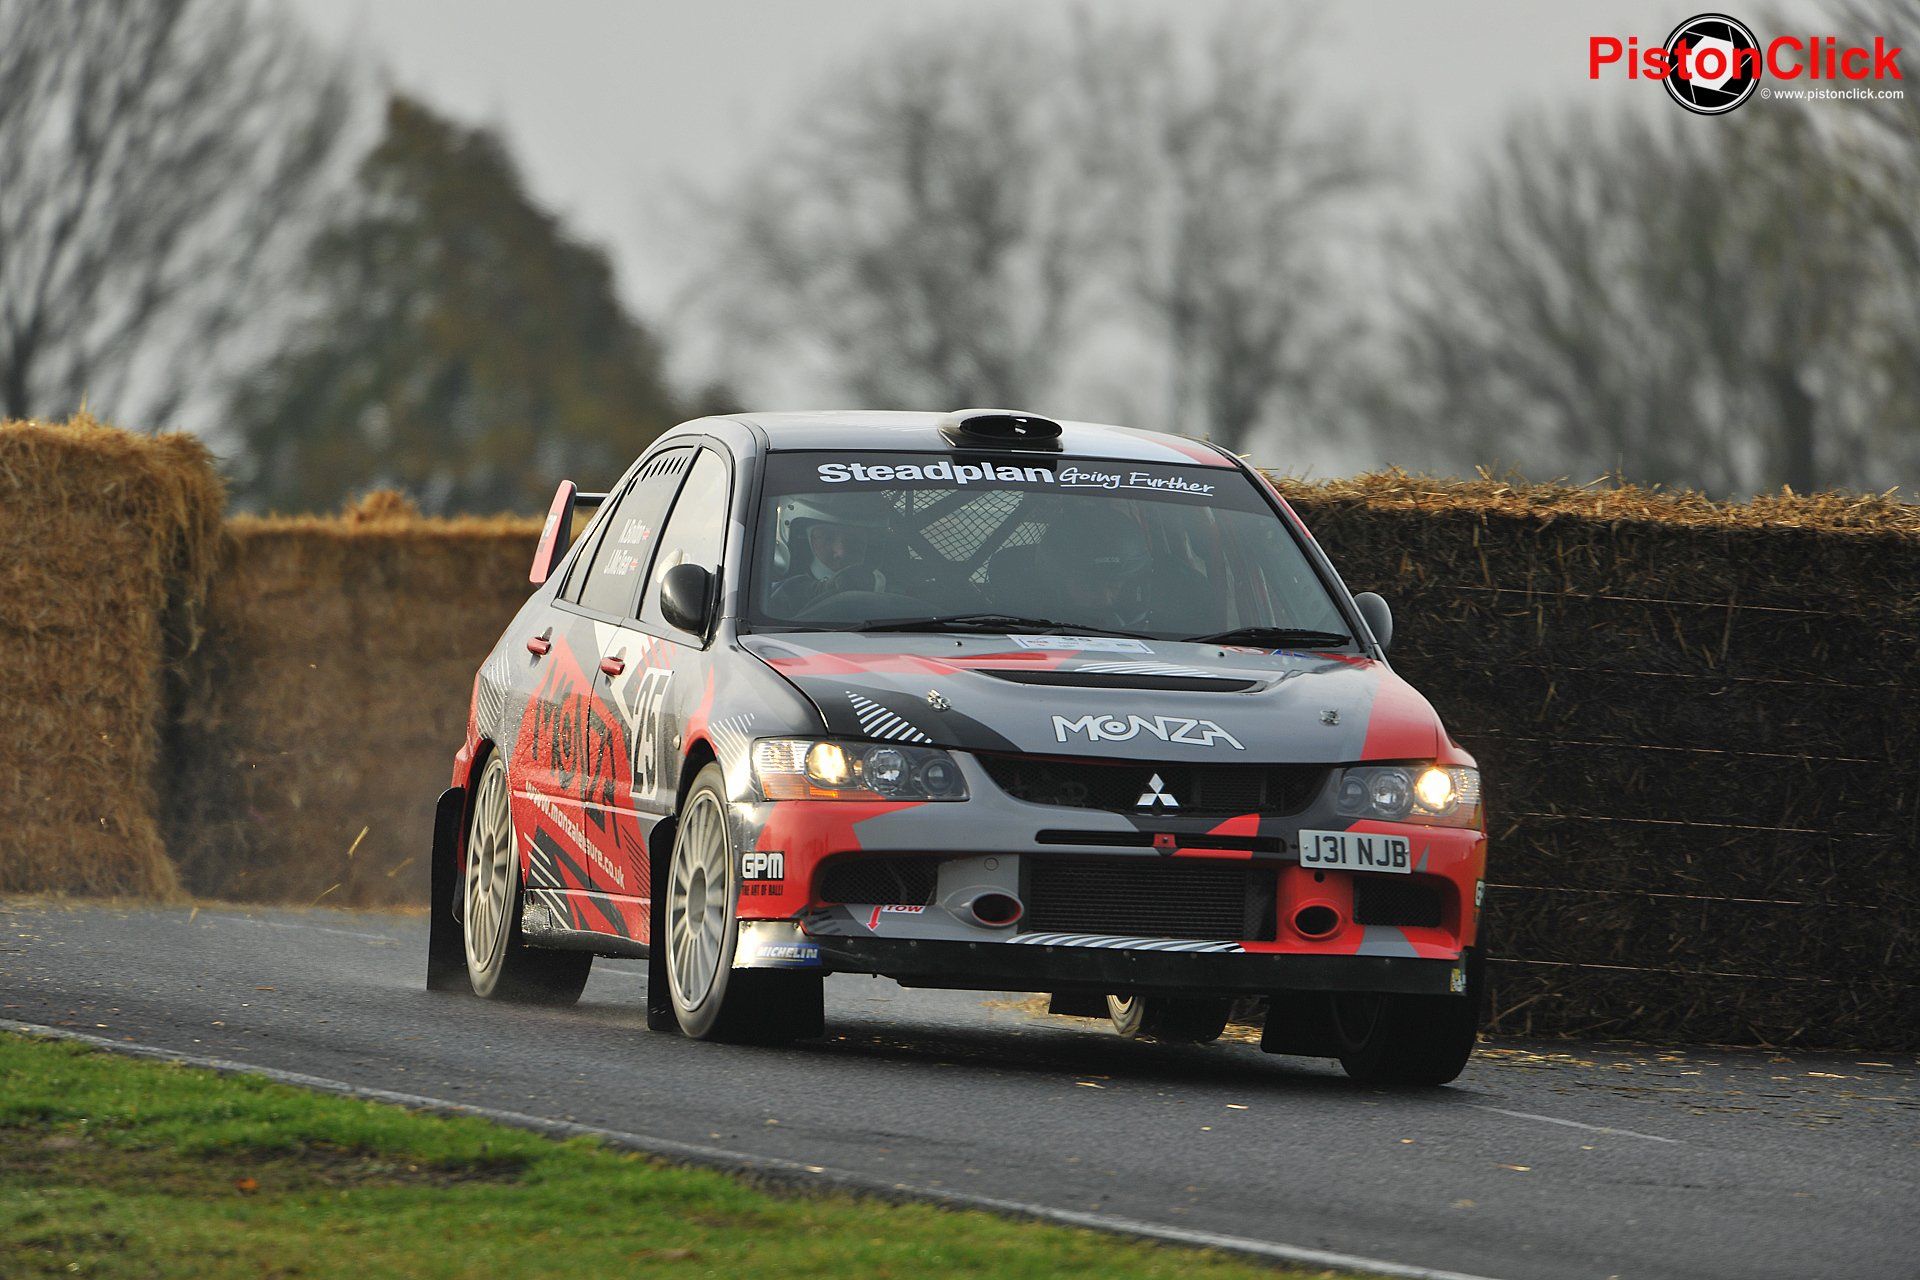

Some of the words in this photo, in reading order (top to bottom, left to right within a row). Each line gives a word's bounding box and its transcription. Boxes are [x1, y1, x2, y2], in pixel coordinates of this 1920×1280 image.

[817, 461, 1056, 485] Steadplan
[1059, 467, 1121, 490] Going
[1130, 472, 1215, 493] Further
[632, 673, 670, 795] 25
[1052, 715, 1246, 751] MONZA
[741, 852, 784, 879] GPM
[1305, 835, 1347, 864] J31
[1357, 837, 1407, 868] NJB
[758, 946, 818, 959] MICHELIN
